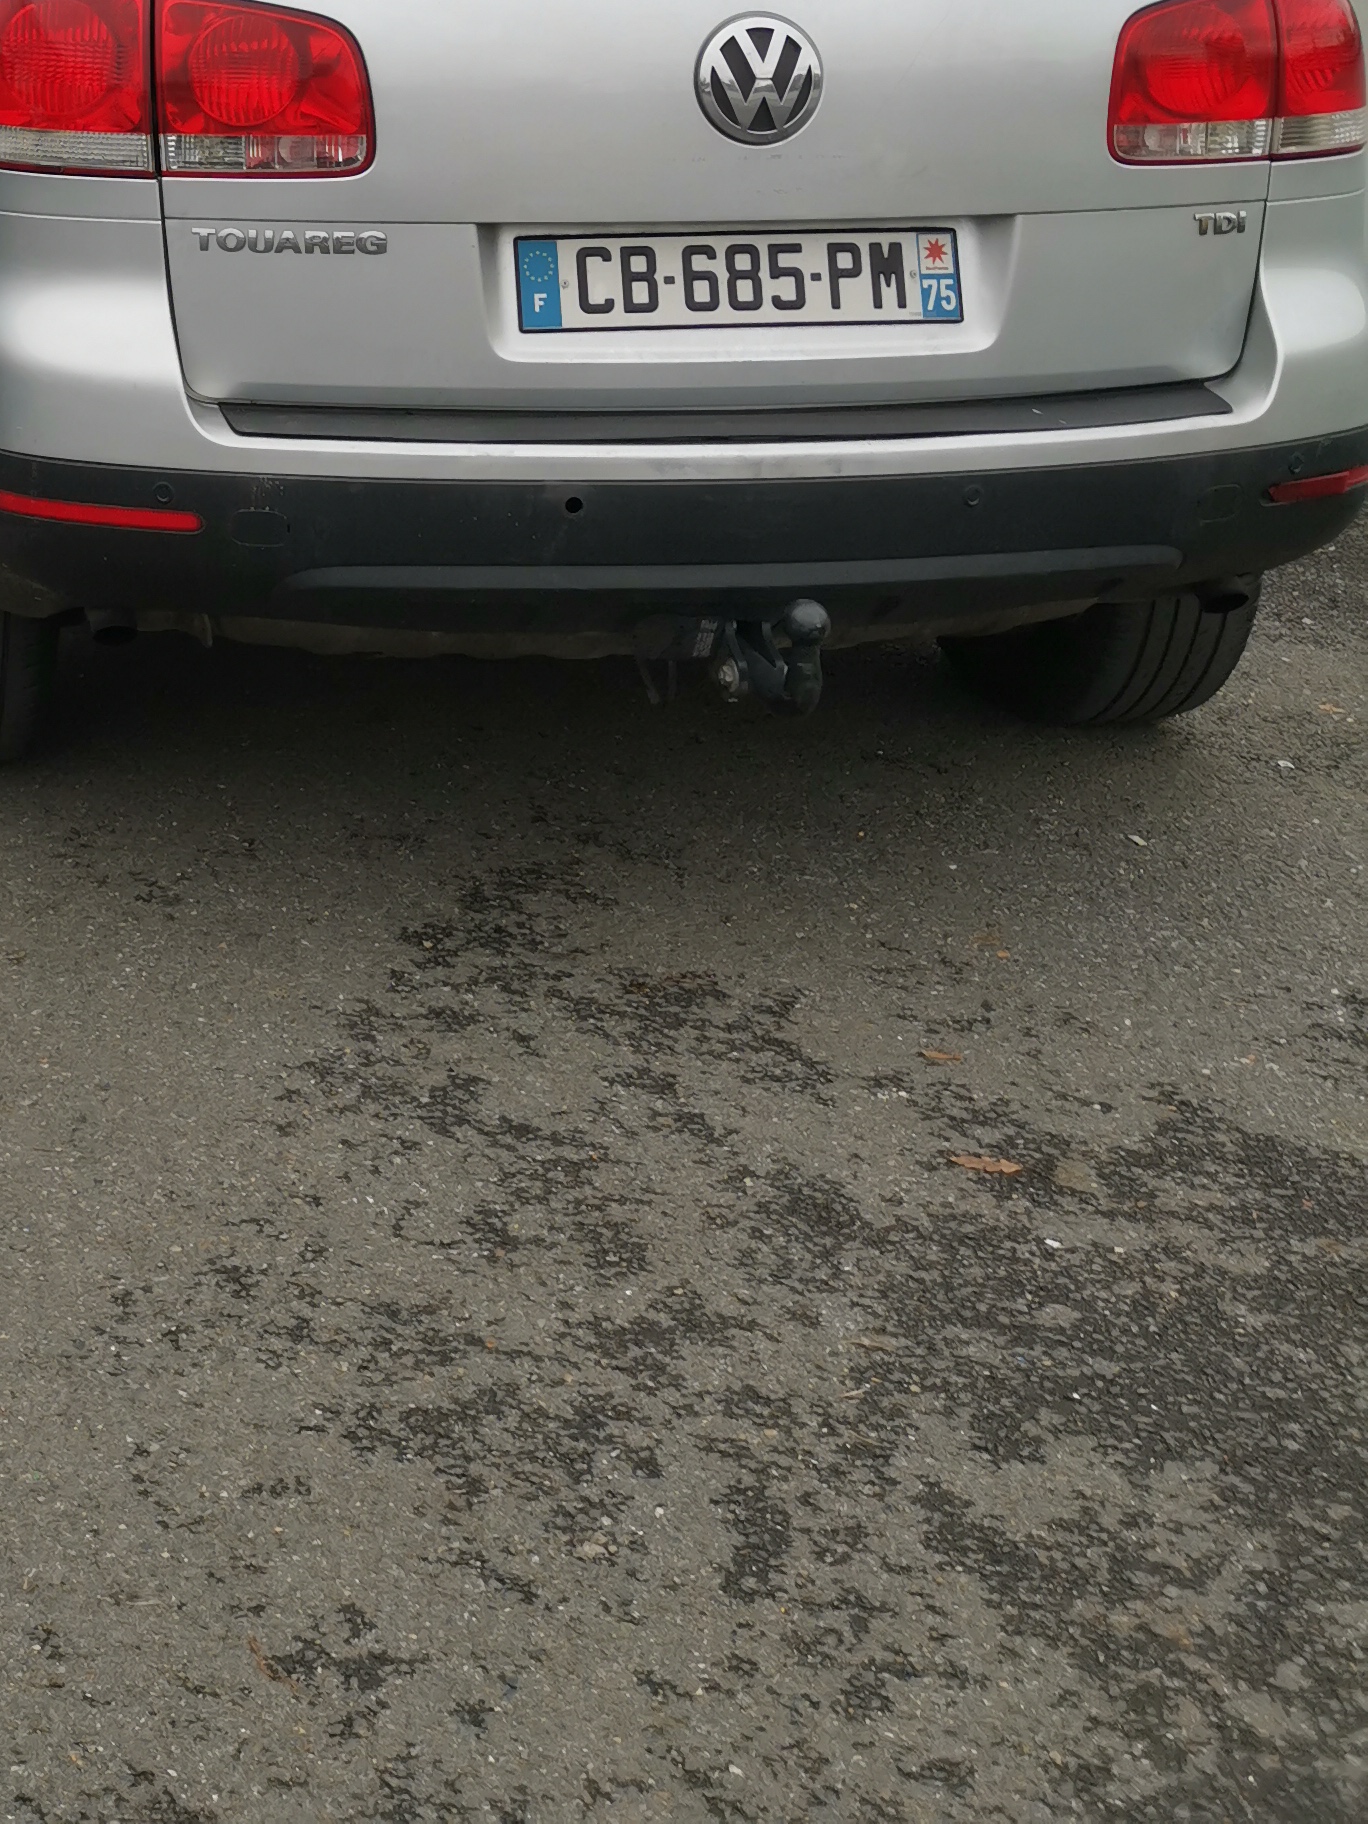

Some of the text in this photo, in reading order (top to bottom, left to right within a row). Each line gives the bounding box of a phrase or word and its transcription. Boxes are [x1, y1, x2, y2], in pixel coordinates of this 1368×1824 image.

[697, 14, 821, 143] VW
[1193, 210, 1247, 236] TDI
[191, 227, 388, 256] TOUAREG
[575, 242, 908, 314] CB-685-PM
[533, 292, 548, 313] F
[921, 278, 957, 311] 75
